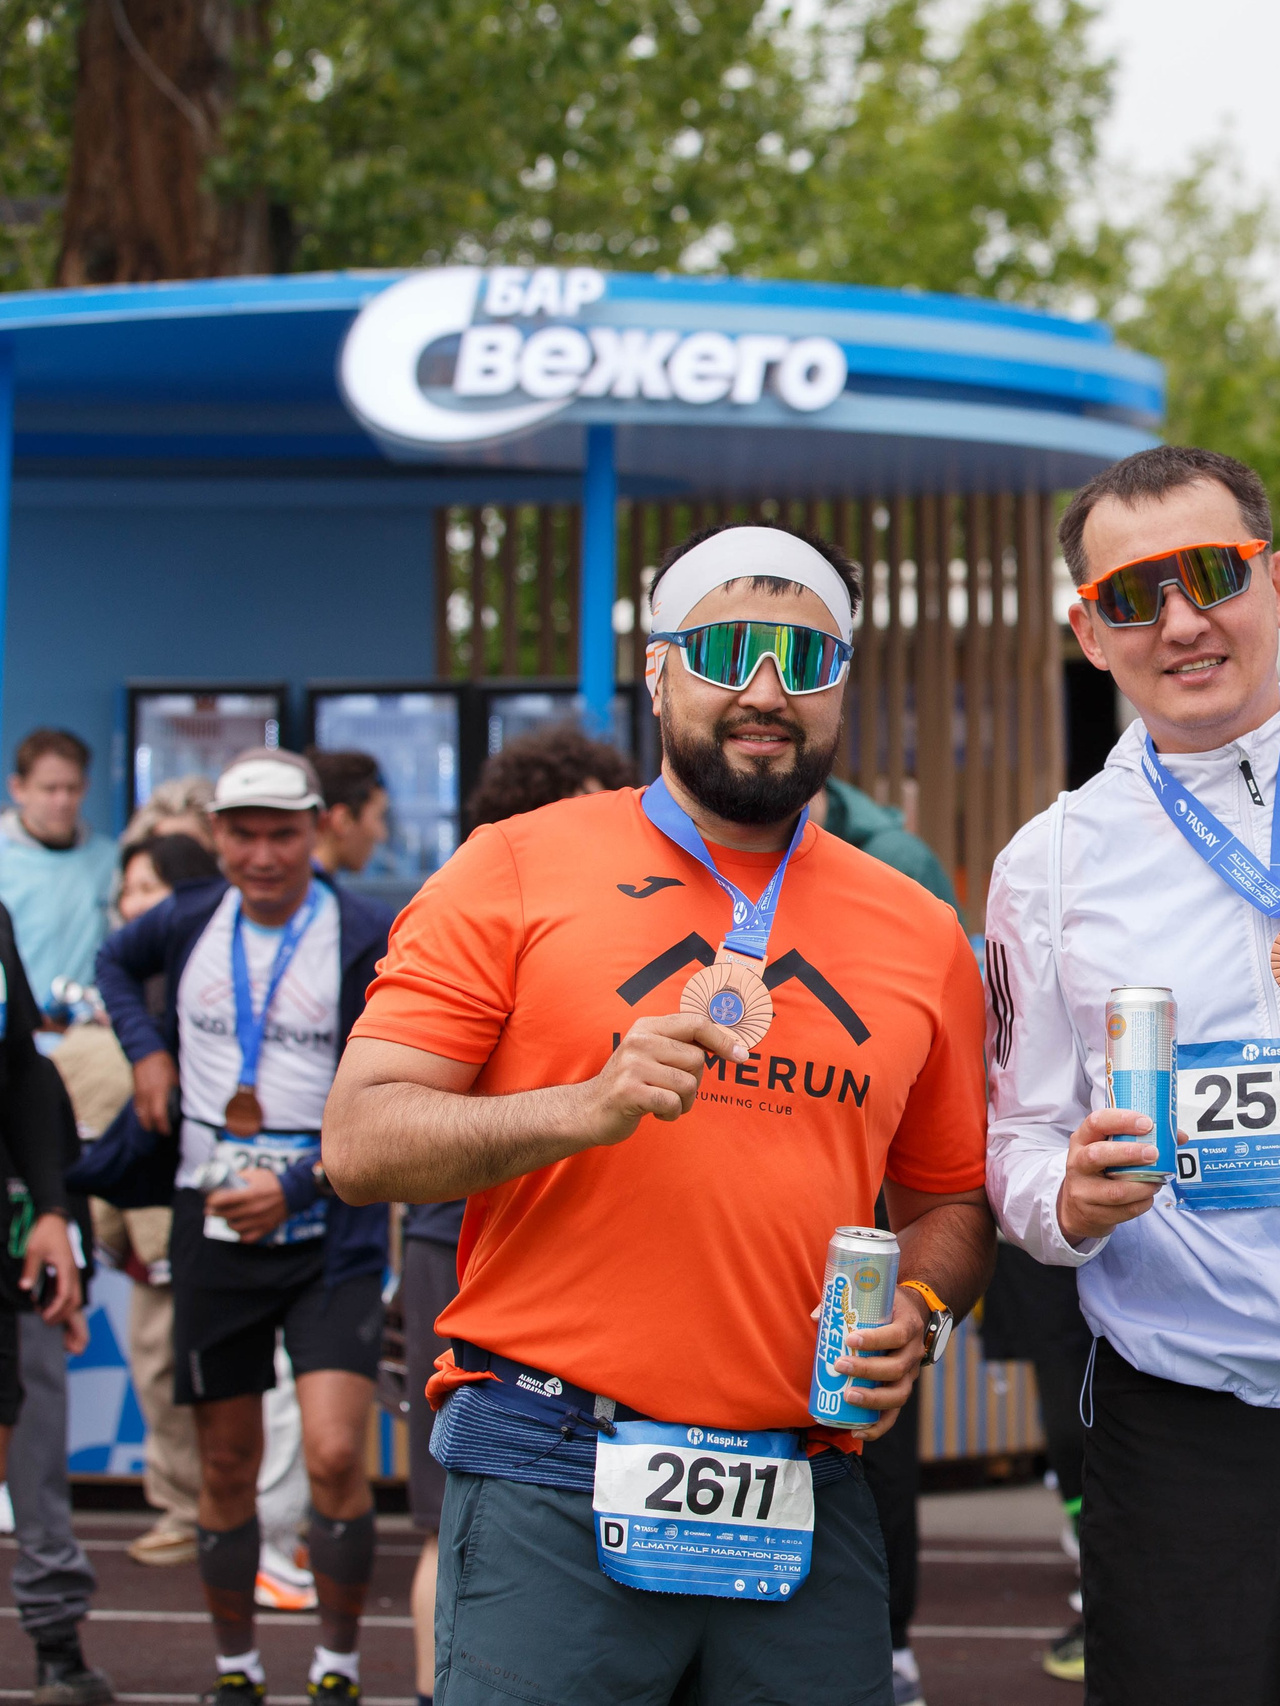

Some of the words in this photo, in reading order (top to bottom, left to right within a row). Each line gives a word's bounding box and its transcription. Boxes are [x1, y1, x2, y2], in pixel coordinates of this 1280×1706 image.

[485, 267, 605, 317] БАР
[1184, 809, 1221, 850] TASSAY
[1230, 852, 1265, 884] ALMATY
[1231, 868, 1276, 908] MARATHON
[612, 1032, 871, 1108] MERUN
[694, 1091, 753, 1109] RUNNING
[759, 1101, 793, 1116] CLUB
[1177, 1153, 1197, 1180] D
[1204, 1160, 1251, 1171] ALMATY
[818, 1284, 834, 1355] КРУЖКА
[516, 1380, 552, 1398] MARATHON
[518, 1373, 543, 1388] ALMATY
[818, 1390, 840, 1414] 0.0
[706, 1434, 749, 1448] Kaspi.kz
[645, 1452, 779, 1520] 2611
[604, 1521, 625, 1548] D
[632, 1541, 679, 1551] ALMATY
[680, 1546, 709, 1554] HALF
[711, 1548, 772, 1560] MARATHON
[773, 1553, 802, 1562] 2026
[788, 1565, 801, 1573] KM
